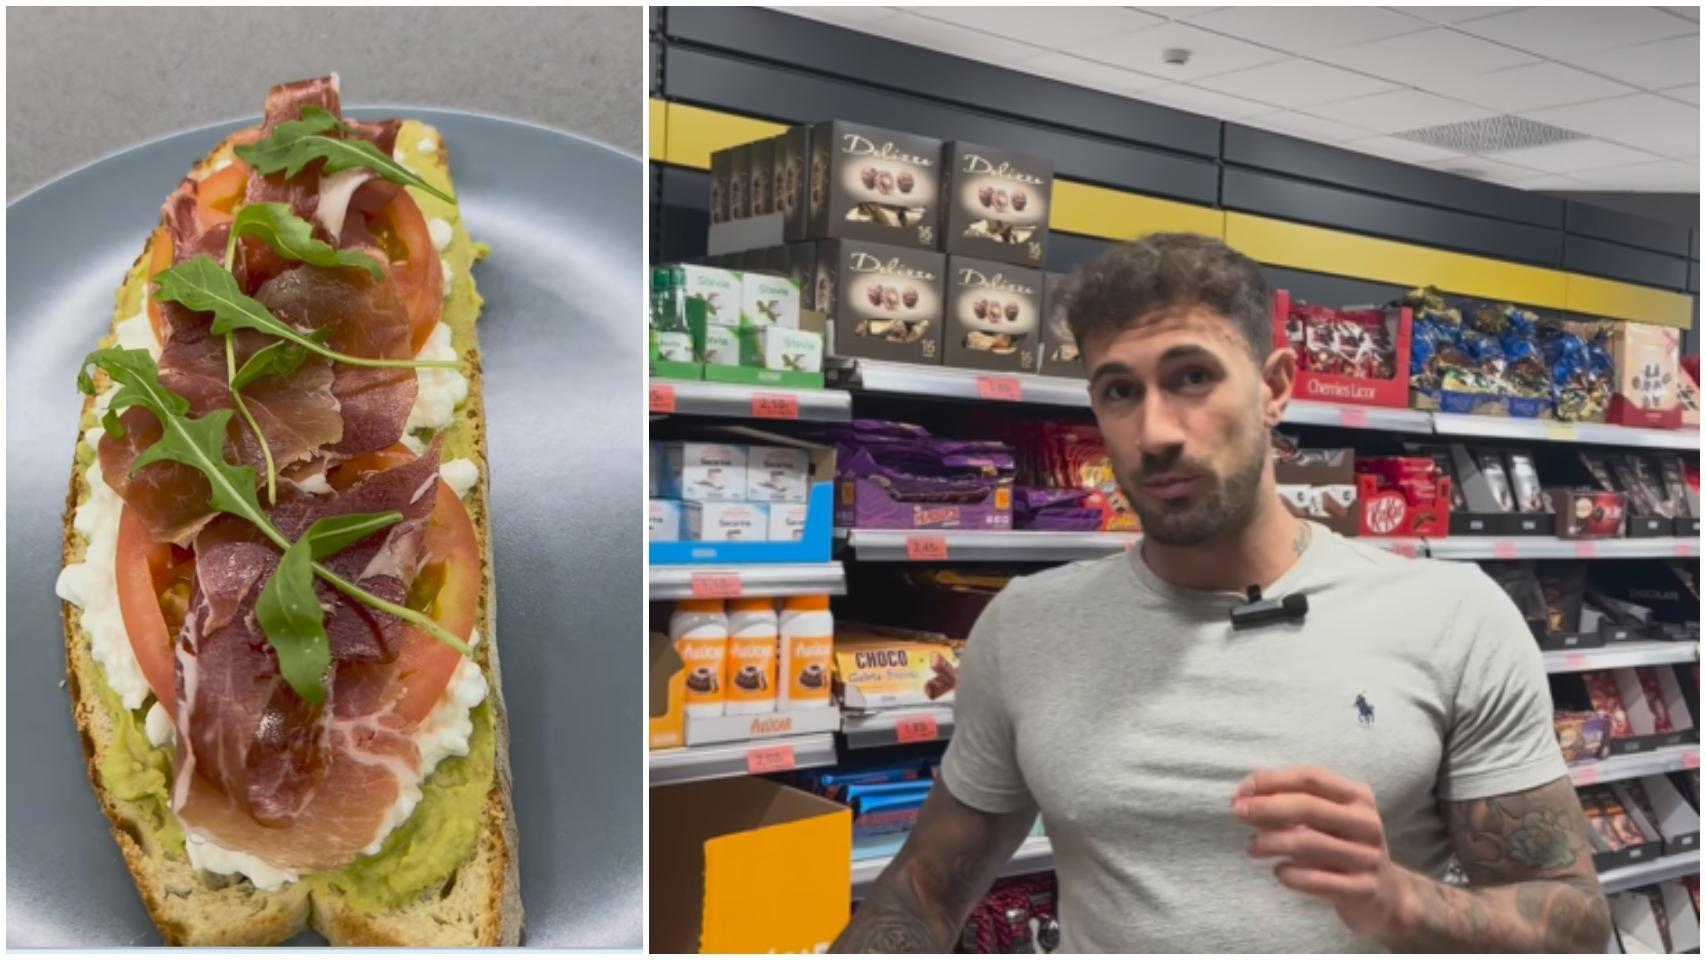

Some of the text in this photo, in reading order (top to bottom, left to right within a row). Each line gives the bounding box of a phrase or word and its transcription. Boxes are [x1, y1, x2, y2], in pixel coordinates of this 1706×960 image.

[758, 283, 790, 297] Stevia
[1308, 378, 1350, 397] Cherries
[855, 649, 908, 669] CHOCO
